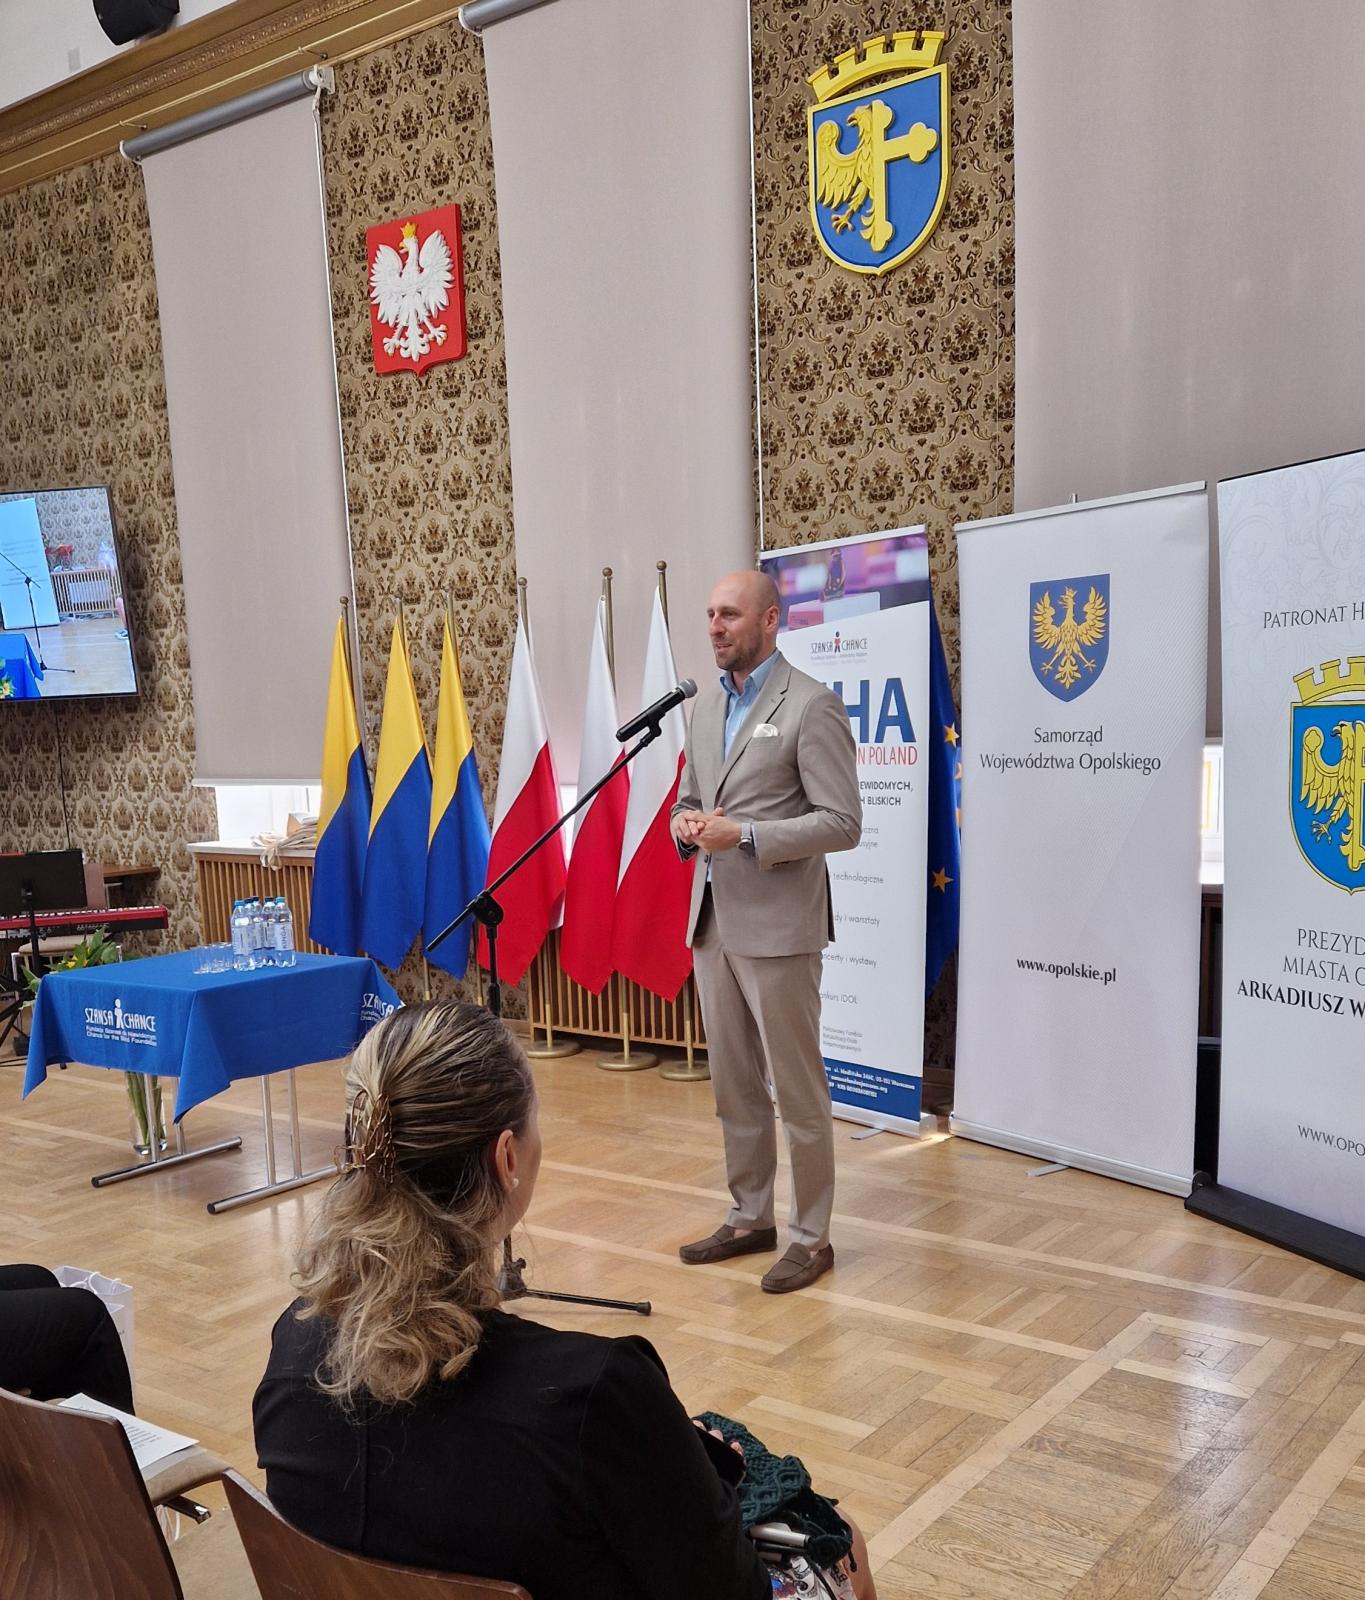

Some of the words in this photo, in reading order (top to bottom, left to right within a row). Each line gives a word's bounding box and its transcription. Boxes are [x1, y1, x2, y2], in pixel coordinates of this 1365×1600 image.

[1263, 605, 1348, 629] PATRONAT
[811, 641, 834, 654] SZANSA
[842, 638, 868, 651] CHANCE
[822, 677, 917, 744] HA
[1034, 725, 1103, 746] Samorząd
[857, 747, 866, 766] N
[868, 745, 918, 766] POLAND
[980, 752, 1075, 773] Województwa
[1079, 752, 1161, 776] Opolskiego
[859, 780, 914, 793] EWIDOMYCH,
[867, 795, 902, 807] BLISKICH
[1297, 927, 1365, 956] PREZYD
[1016, 958, 1117, 986] www.opolskie.pl
[1283, 955, 1350, 983] MIASTA
[1354, 966, 1365, 987] O
[361, 993, 394, 1017] SZANSA
[1236, 979, 1345, 1016] ARKADIUSZ
[1348, 998, 1365, 1020] W
[85, 1008, 114, 1026] SZANSA
[123, 1013, 156, 1032] CHANCE
[1297, 1124, 1365, 1157] WWW.OPO
